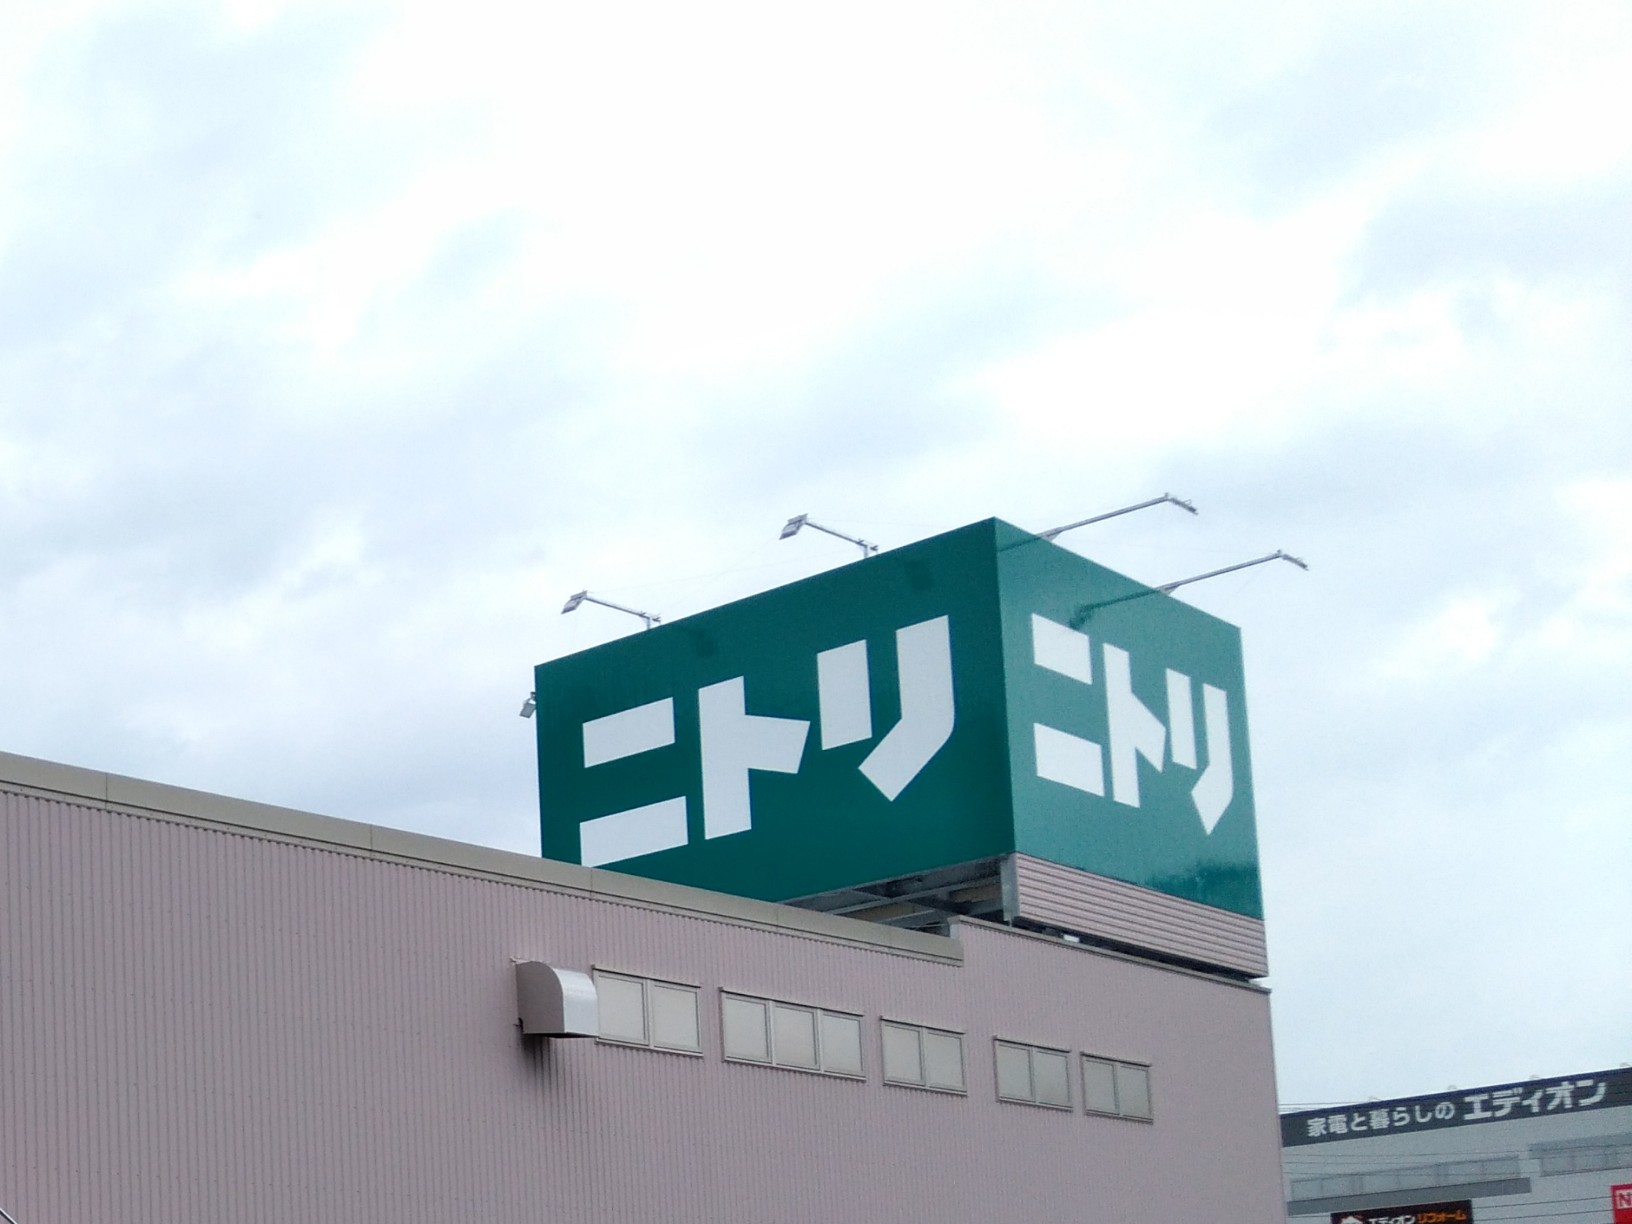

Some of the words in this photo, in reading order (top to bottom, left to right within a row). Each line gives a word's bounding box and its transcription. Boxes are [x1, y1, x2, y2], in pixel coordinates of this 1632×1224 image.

[579, 614, 955, 867] ニトリ
[1031, 612, 1233, 835] ニトリ
[1306, 1101, 1455, 1138] 家電と暮らしの
[1464, 1079, 1606, 1120] エディオン
[1416, 1209, 1467, 1224] リフォーム
